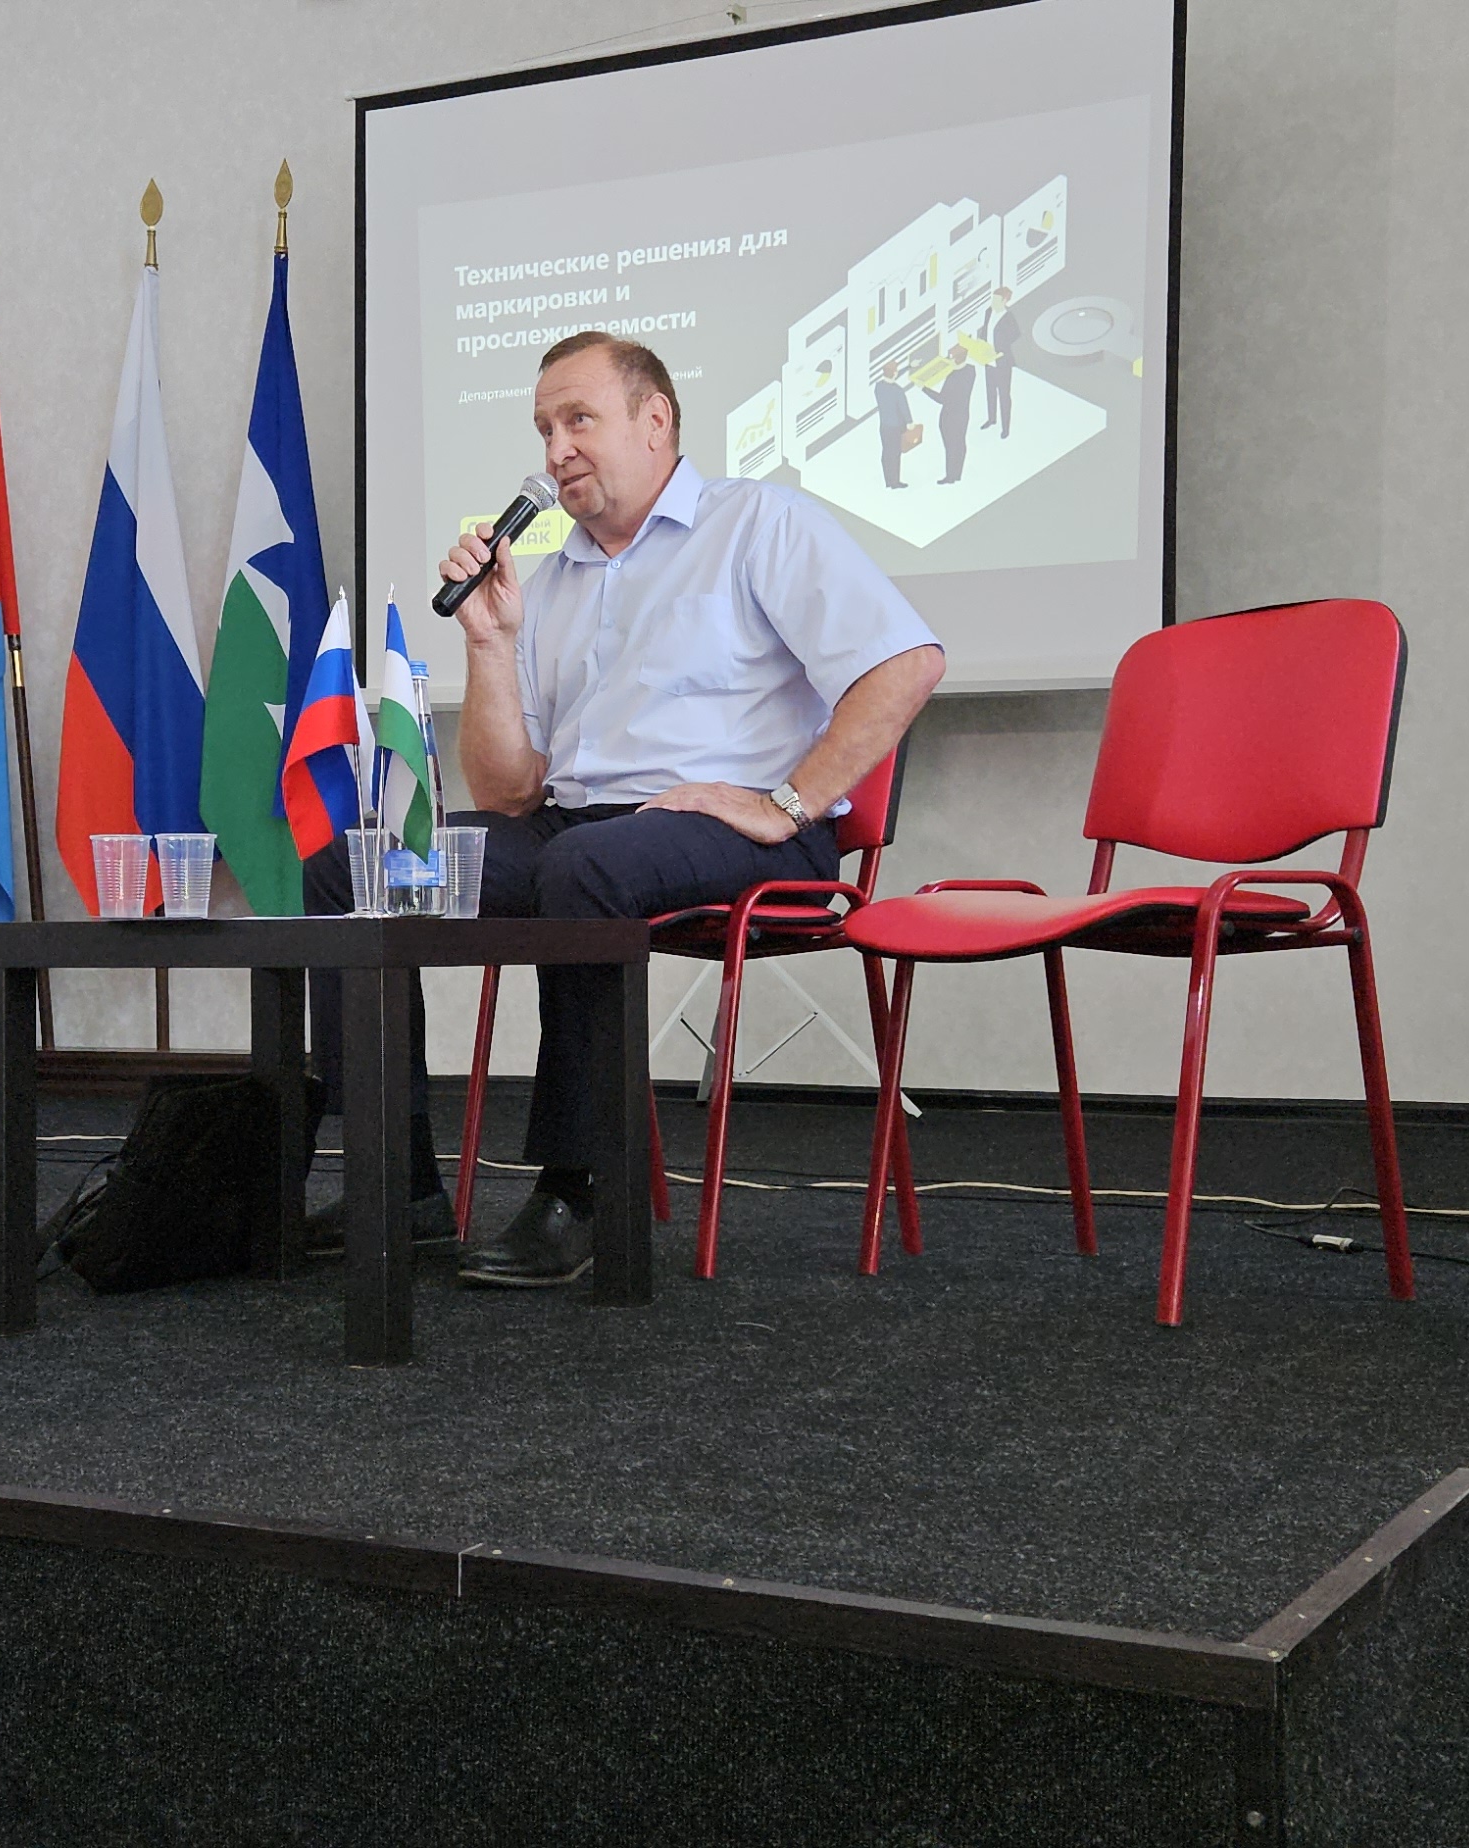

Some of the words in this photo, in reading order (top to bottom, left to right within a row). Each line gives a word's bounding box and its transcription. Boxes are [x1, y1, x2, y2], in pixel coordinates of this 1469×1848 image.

[454, 251, 610, 287] Технические
[617, 236, 731, 274] решения
[738, 228, 788, 256] для
[456, 286, 608, 323] маркировки
[616, 284, 631, 302] и
[458, 385, 534, 405] Департамент
[669, 365, 703, 381] ений
